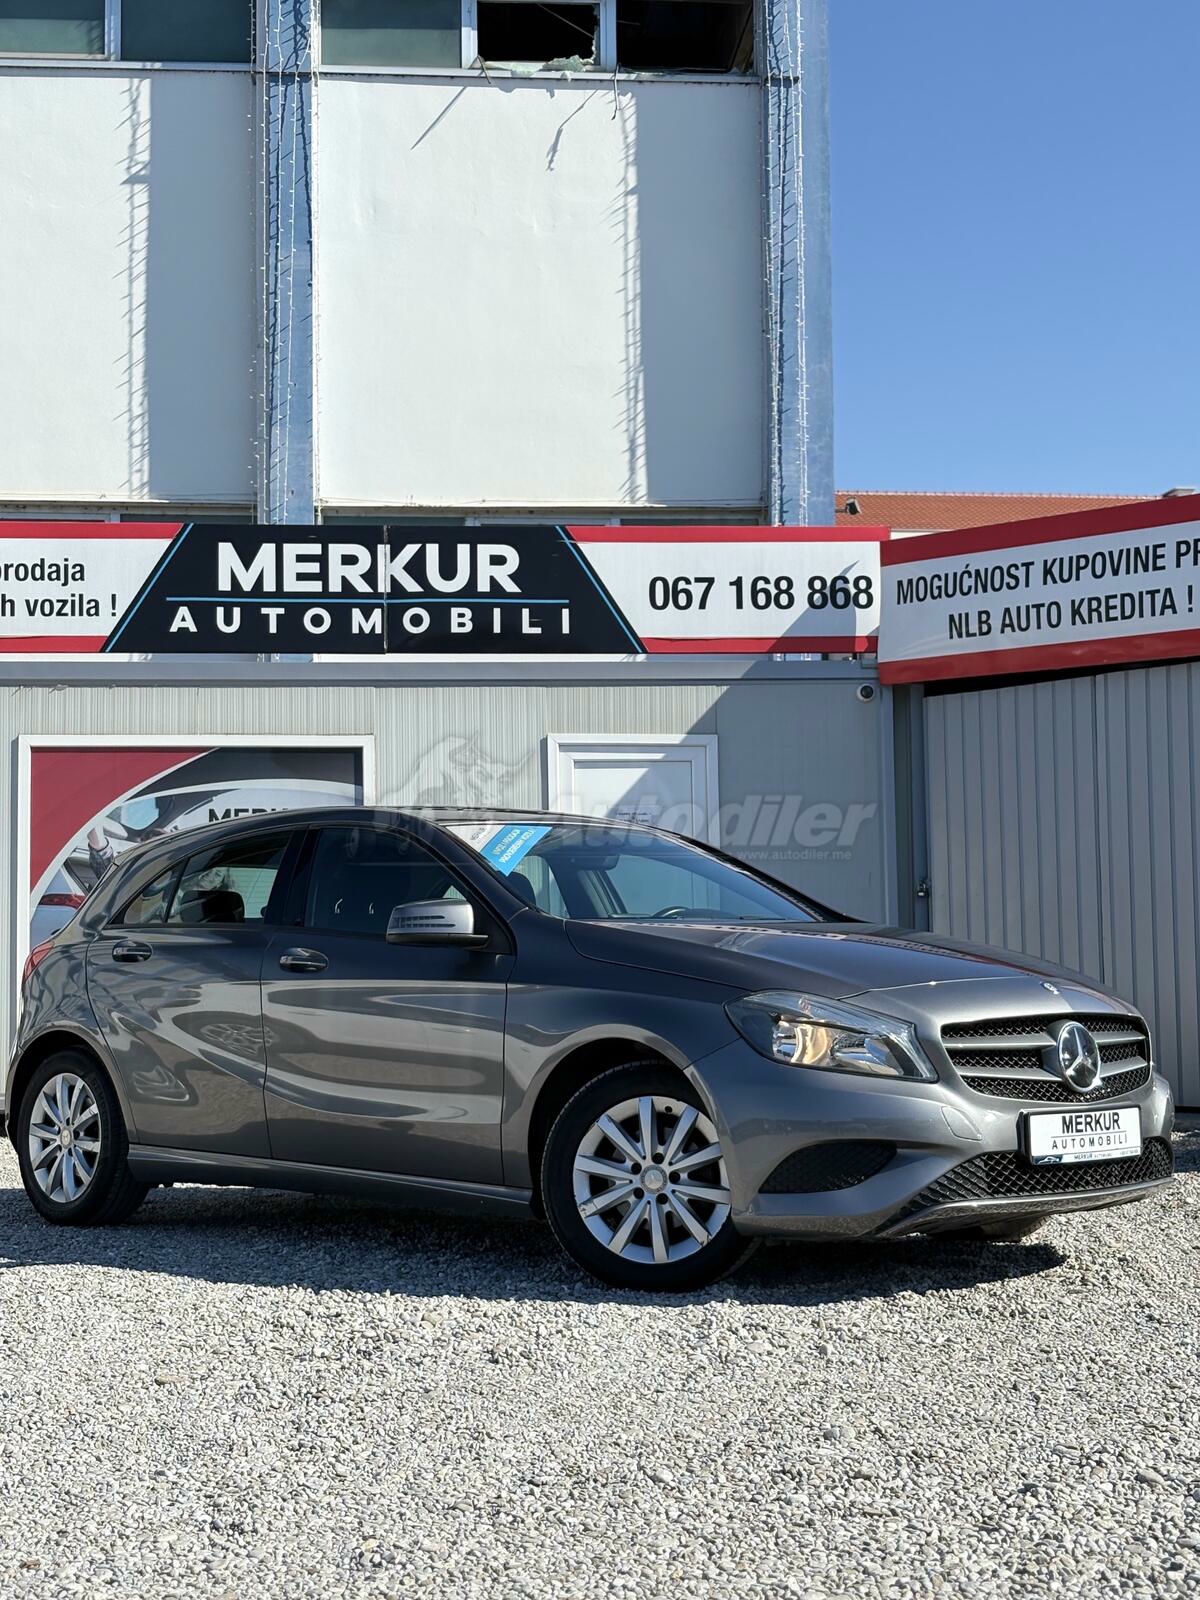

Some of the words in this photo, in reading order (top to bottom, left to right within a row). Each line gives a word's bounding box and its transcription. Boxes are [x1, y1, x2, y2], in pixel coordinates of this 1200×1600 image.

[0, 558, 85, 586] rodaja
[217, 542, 523, 593] MERKUR
[896, 560, 1035, 605] MOGUĆNOST
[1042, 543, 1166, 586] KUPOVINE
[24, 593, 100, 617] vozila
[649, 576, 716, 610] 067
[729, 576, 795, 610] 168
[807, 575, 873, 610] 868
[169, 605, 571, 635] AUTOMOBILI
[948, 609, 992, 640] NLB
[1000, 600, 1062, 634] AUTO
[1070, 587, 1178, 626] KREDITA
[1061, 1111, 1121, 1135] MERKUR
[1051, 1133, 1128, 1150] AUTOMOBILI
